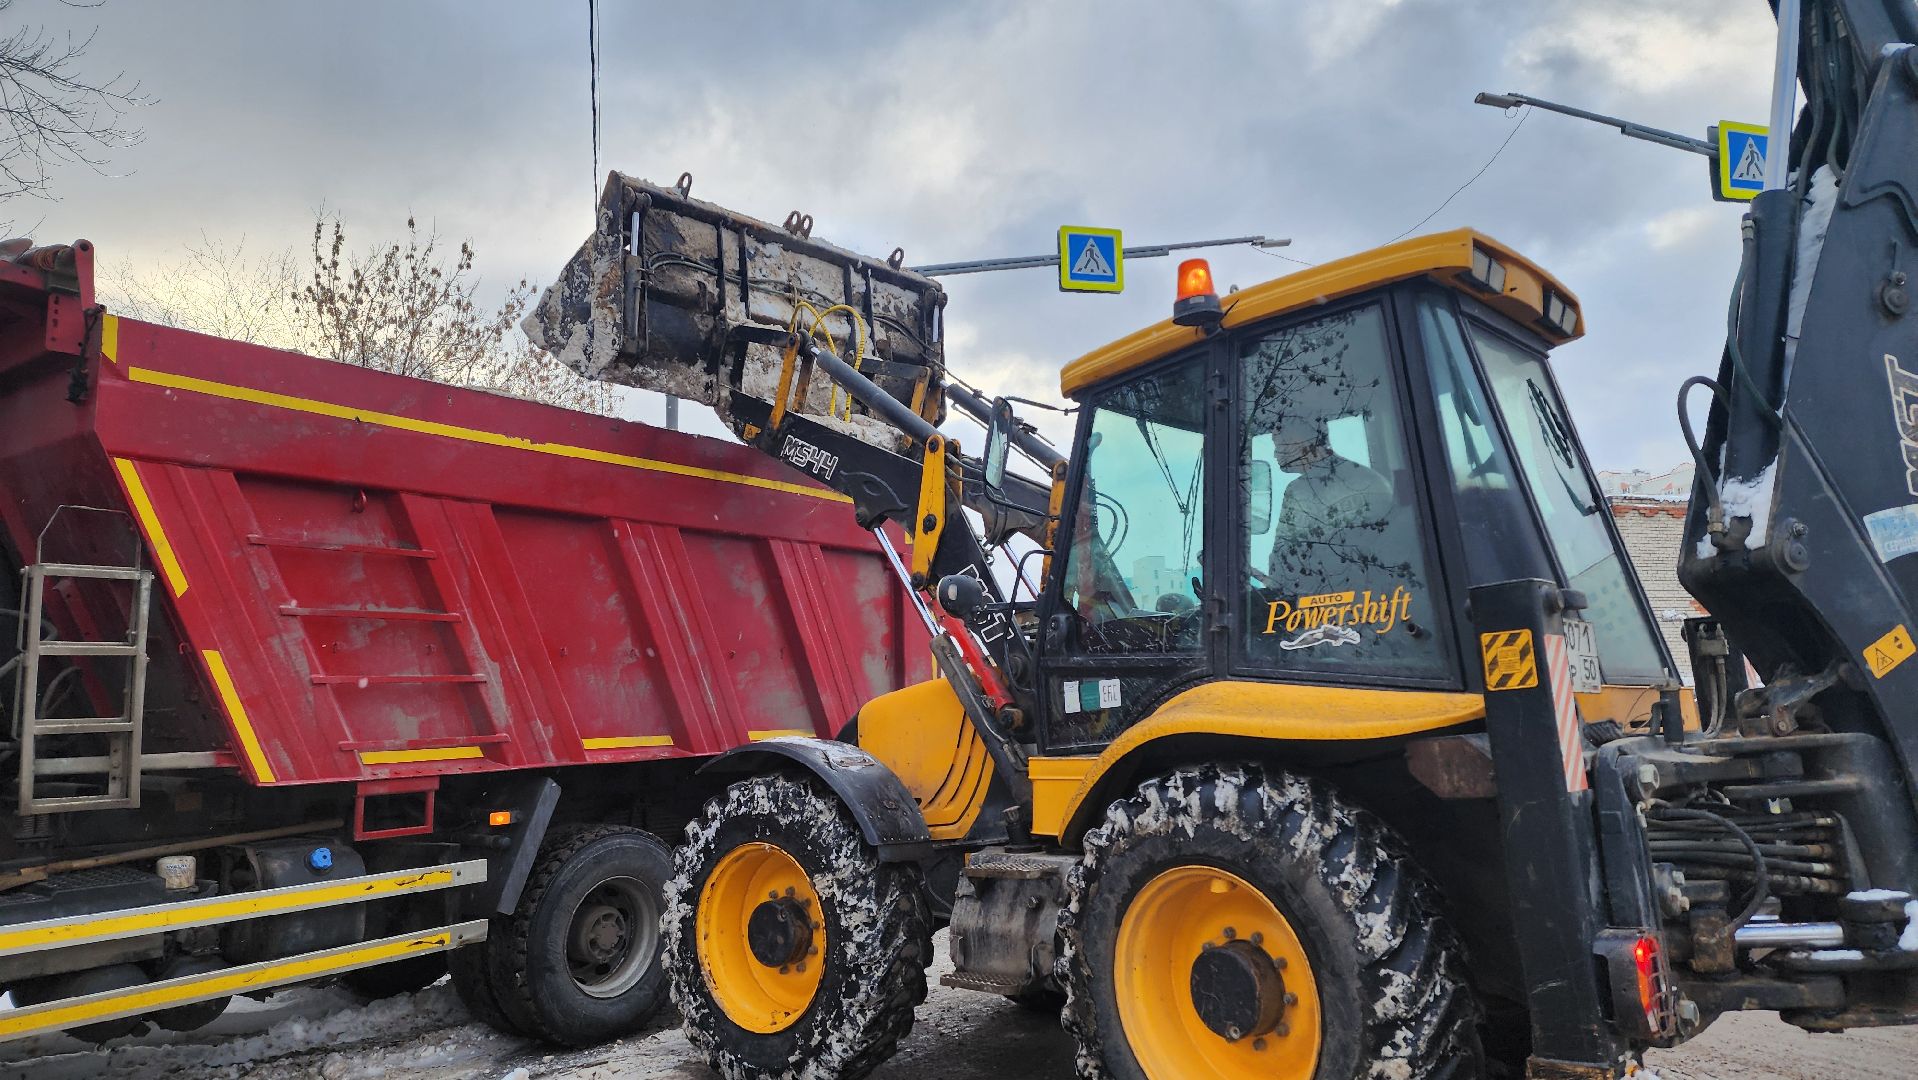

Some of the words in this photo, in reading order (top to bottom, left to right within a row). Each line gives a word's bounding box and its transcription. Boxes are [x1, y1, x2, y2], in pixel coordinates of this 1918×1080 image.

[1262, 585, 1413, 634] Powershift
[1310, 594, 1344, 606] AUTO
[1583, 658, 1597, 681] 50
